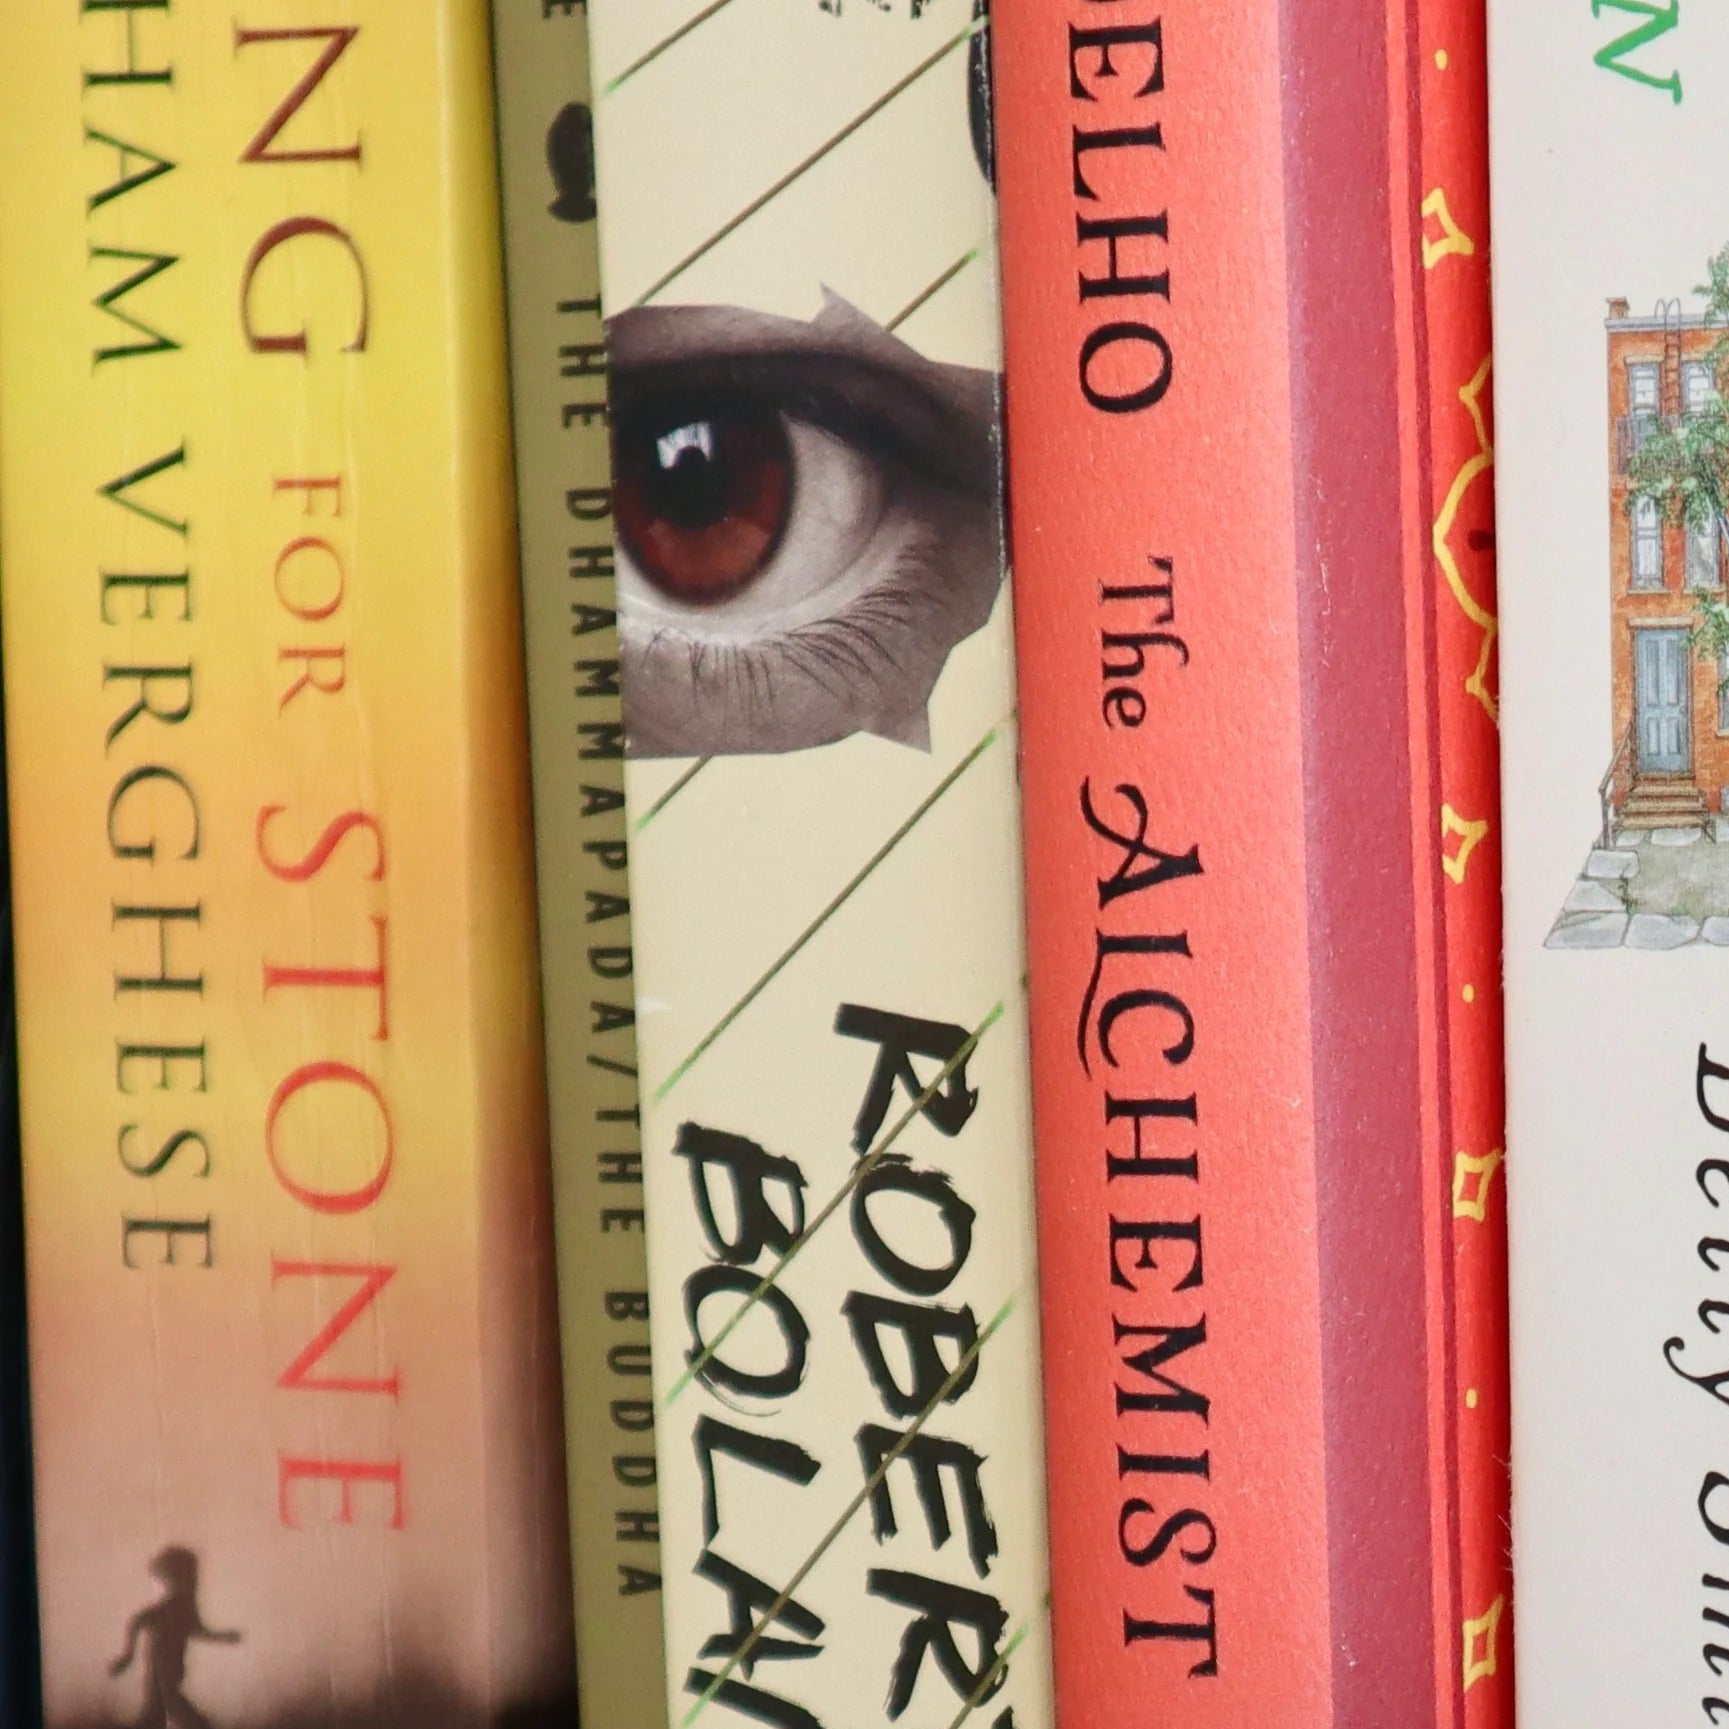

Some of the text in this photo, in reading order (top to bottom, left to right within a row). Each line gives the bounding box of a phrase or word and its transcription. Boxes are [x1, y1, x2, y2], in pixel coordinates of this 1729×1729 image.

[96, 436, 215, 1270] VERGHESE
[231, 17, 409, 1531] NG FOR STONE
[555, 292, 611, 430] THE
[605, 1291, 662, 1597] BUDDHA
[1098, 555, 1190, 729] The
[1077, 775, 1220, 1681] ALCHEMIST
